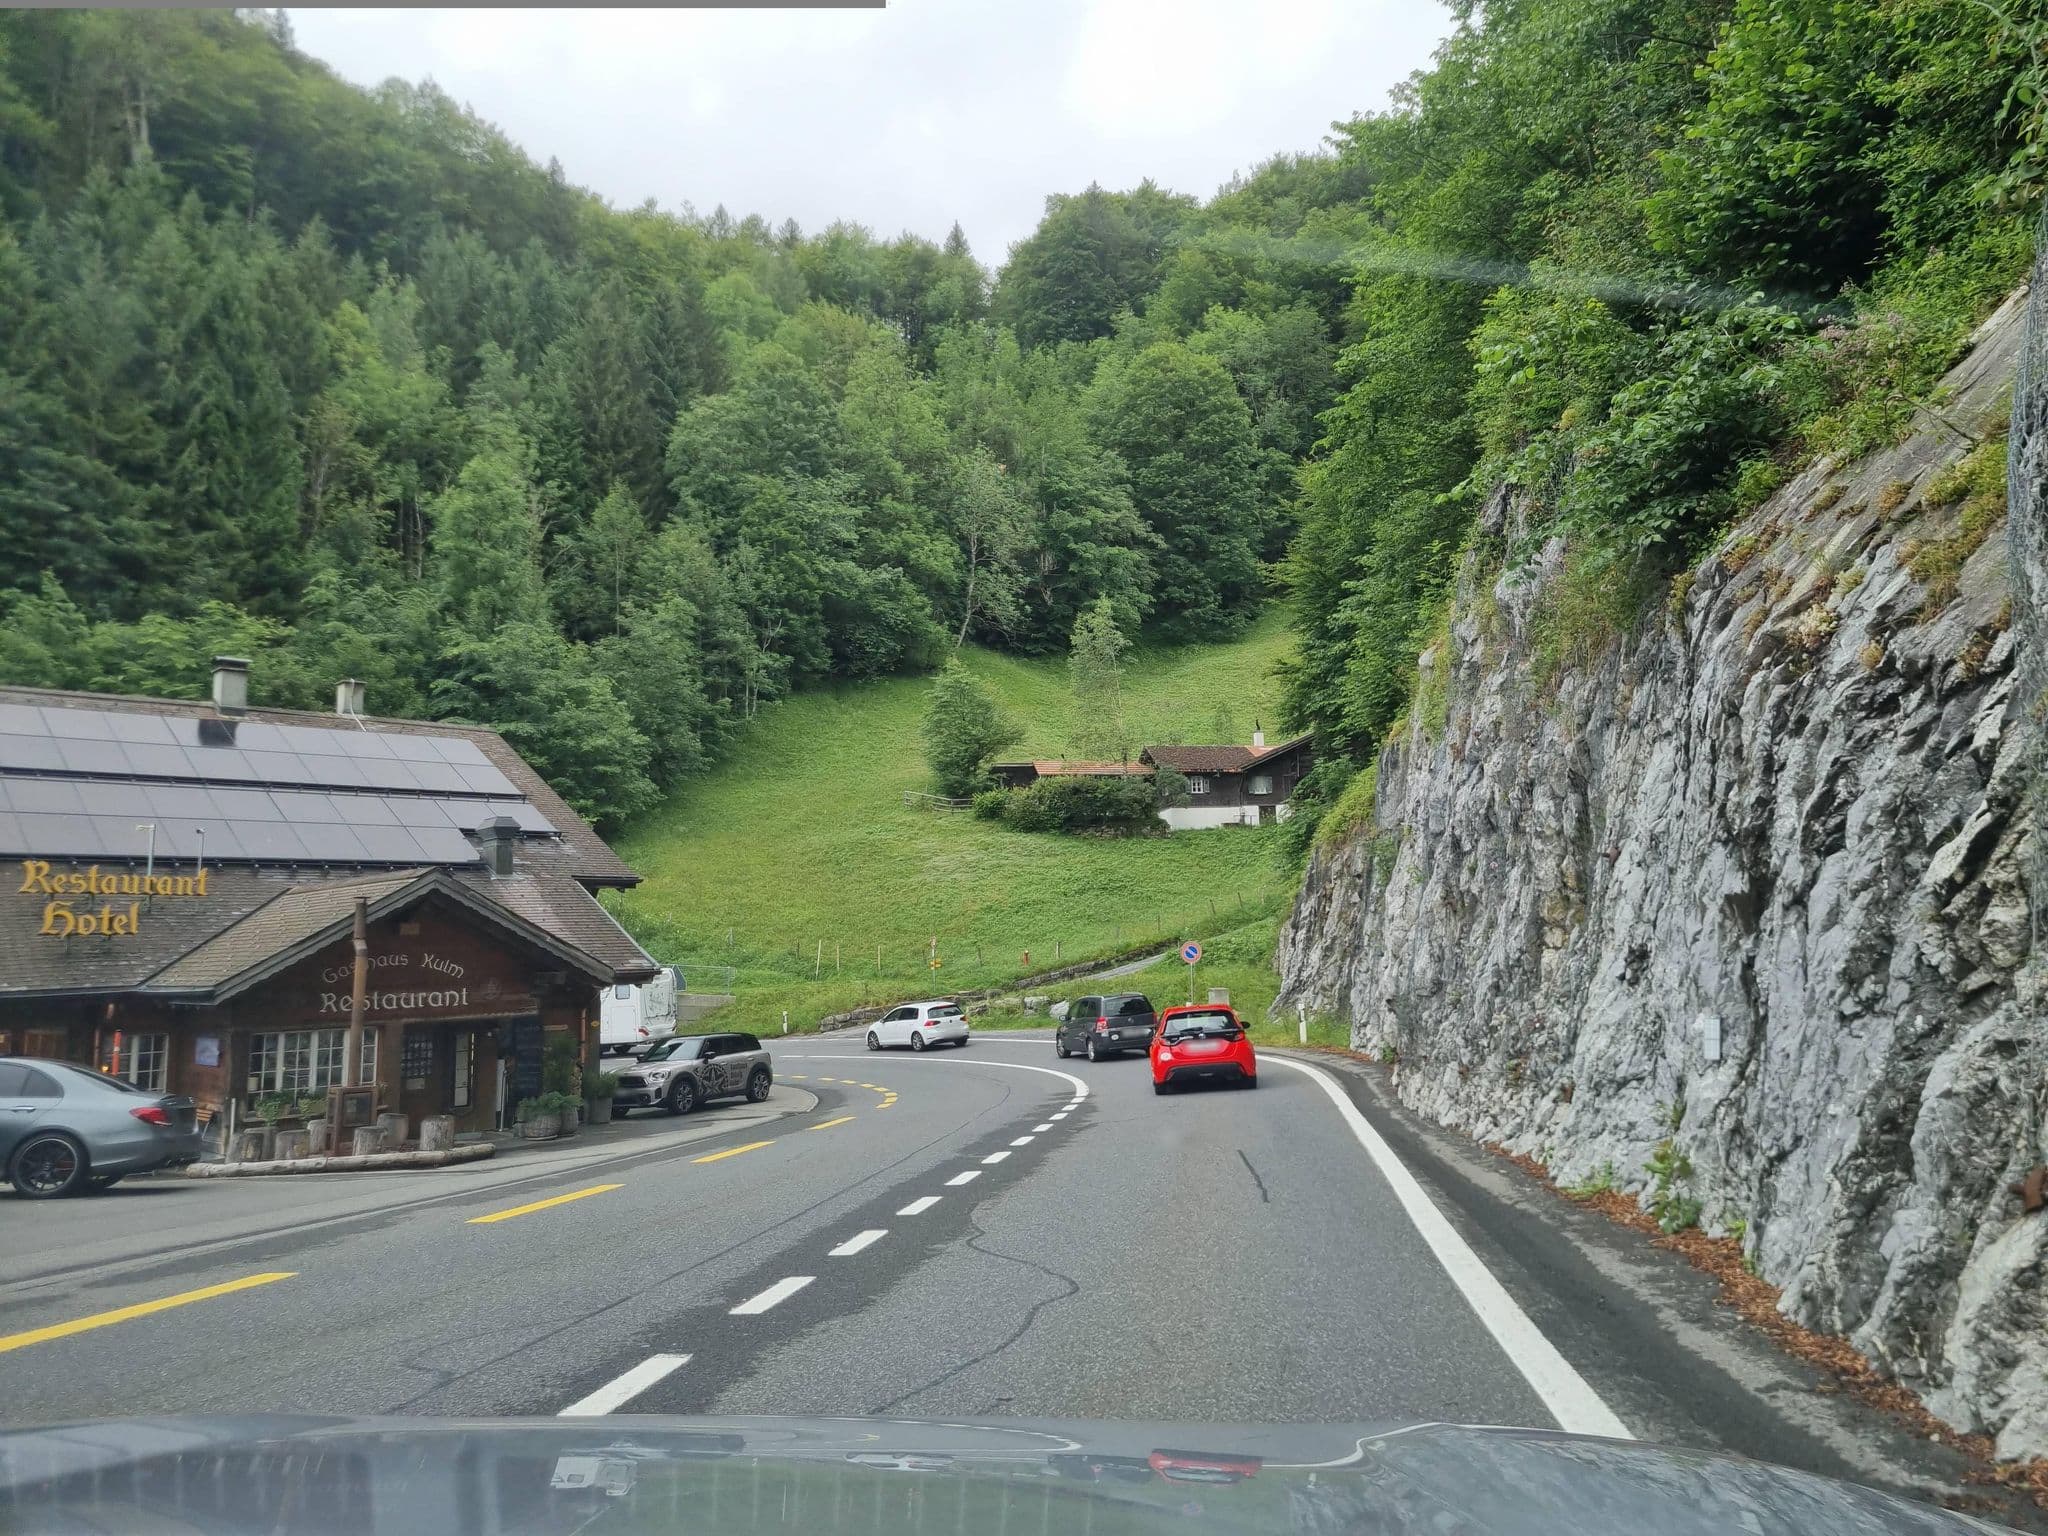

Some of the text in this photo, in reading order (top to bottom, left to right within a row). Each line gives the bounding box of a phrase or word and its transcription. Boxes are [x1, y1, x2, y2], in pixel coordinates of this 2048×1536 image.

[17, 860, 208, 896] Restaurant
[39, 900, 140, 938] Hotel
[421, 952, 465, 979] Kulm
[319, 987, 469, 1013] Restaurant
